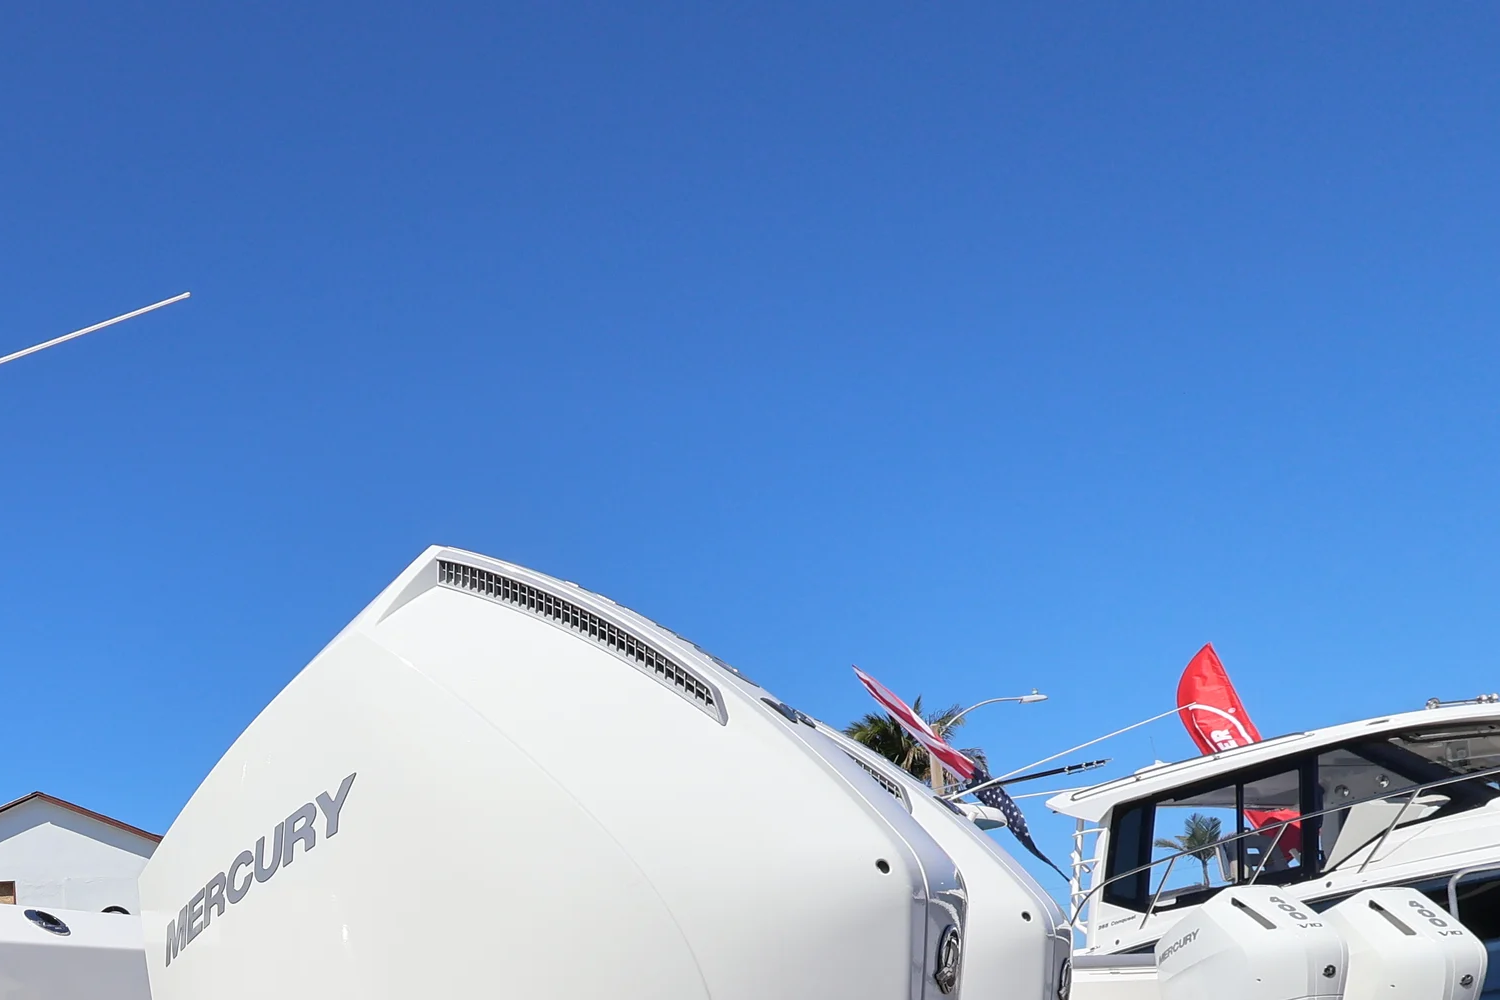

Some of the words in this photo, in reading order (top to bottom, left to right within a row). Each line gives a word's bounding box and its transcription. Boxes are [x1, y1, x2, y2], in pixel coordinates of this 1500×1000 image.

[165, 772, 357, 967] MERCURY
[1269, 896, 1308, 921] 400
[1408, 900, 1448, 928] 400
[1158, 928, 1200, 964] MERCURY
